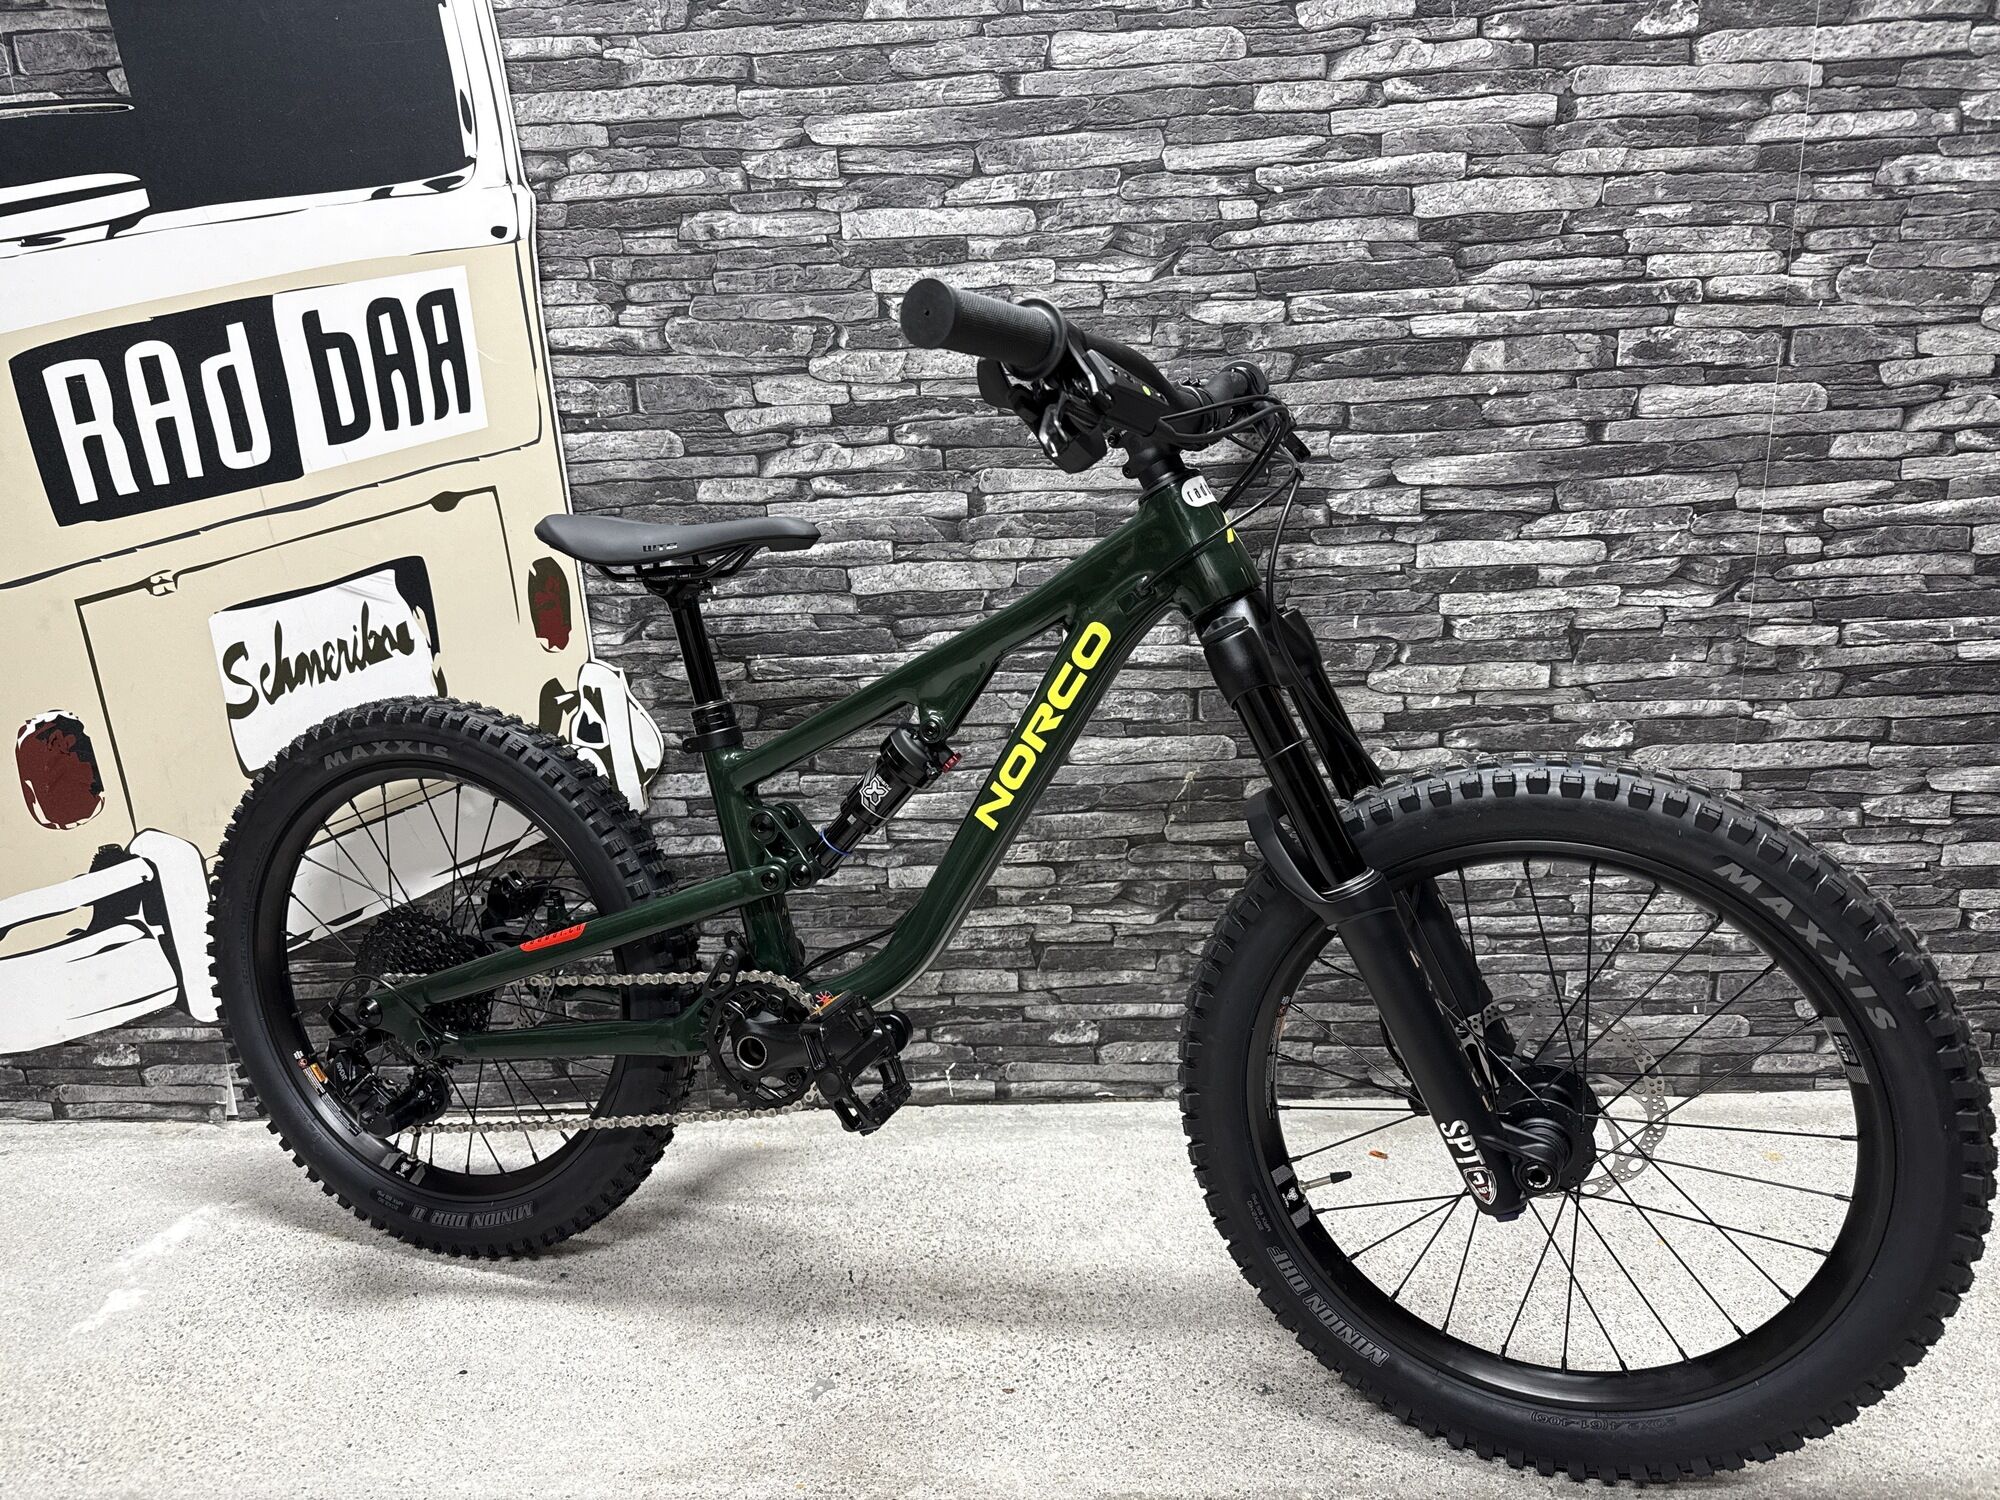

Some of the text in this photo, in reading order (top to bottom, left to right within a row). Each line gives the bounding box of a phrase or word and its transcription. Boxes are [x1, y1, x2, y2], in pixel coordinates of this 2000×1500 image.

[323, 740, 449, 771] MAXXIS
[974, 621, 1112, 832] NORCO
[1712, 861, 1898, 1030] MAXXIS
[431, 1210, 470, 1229] DHR
[471, 1201, 534, 1229] MINION
[1267, 1246, 1389, 1367] MINION DHF
